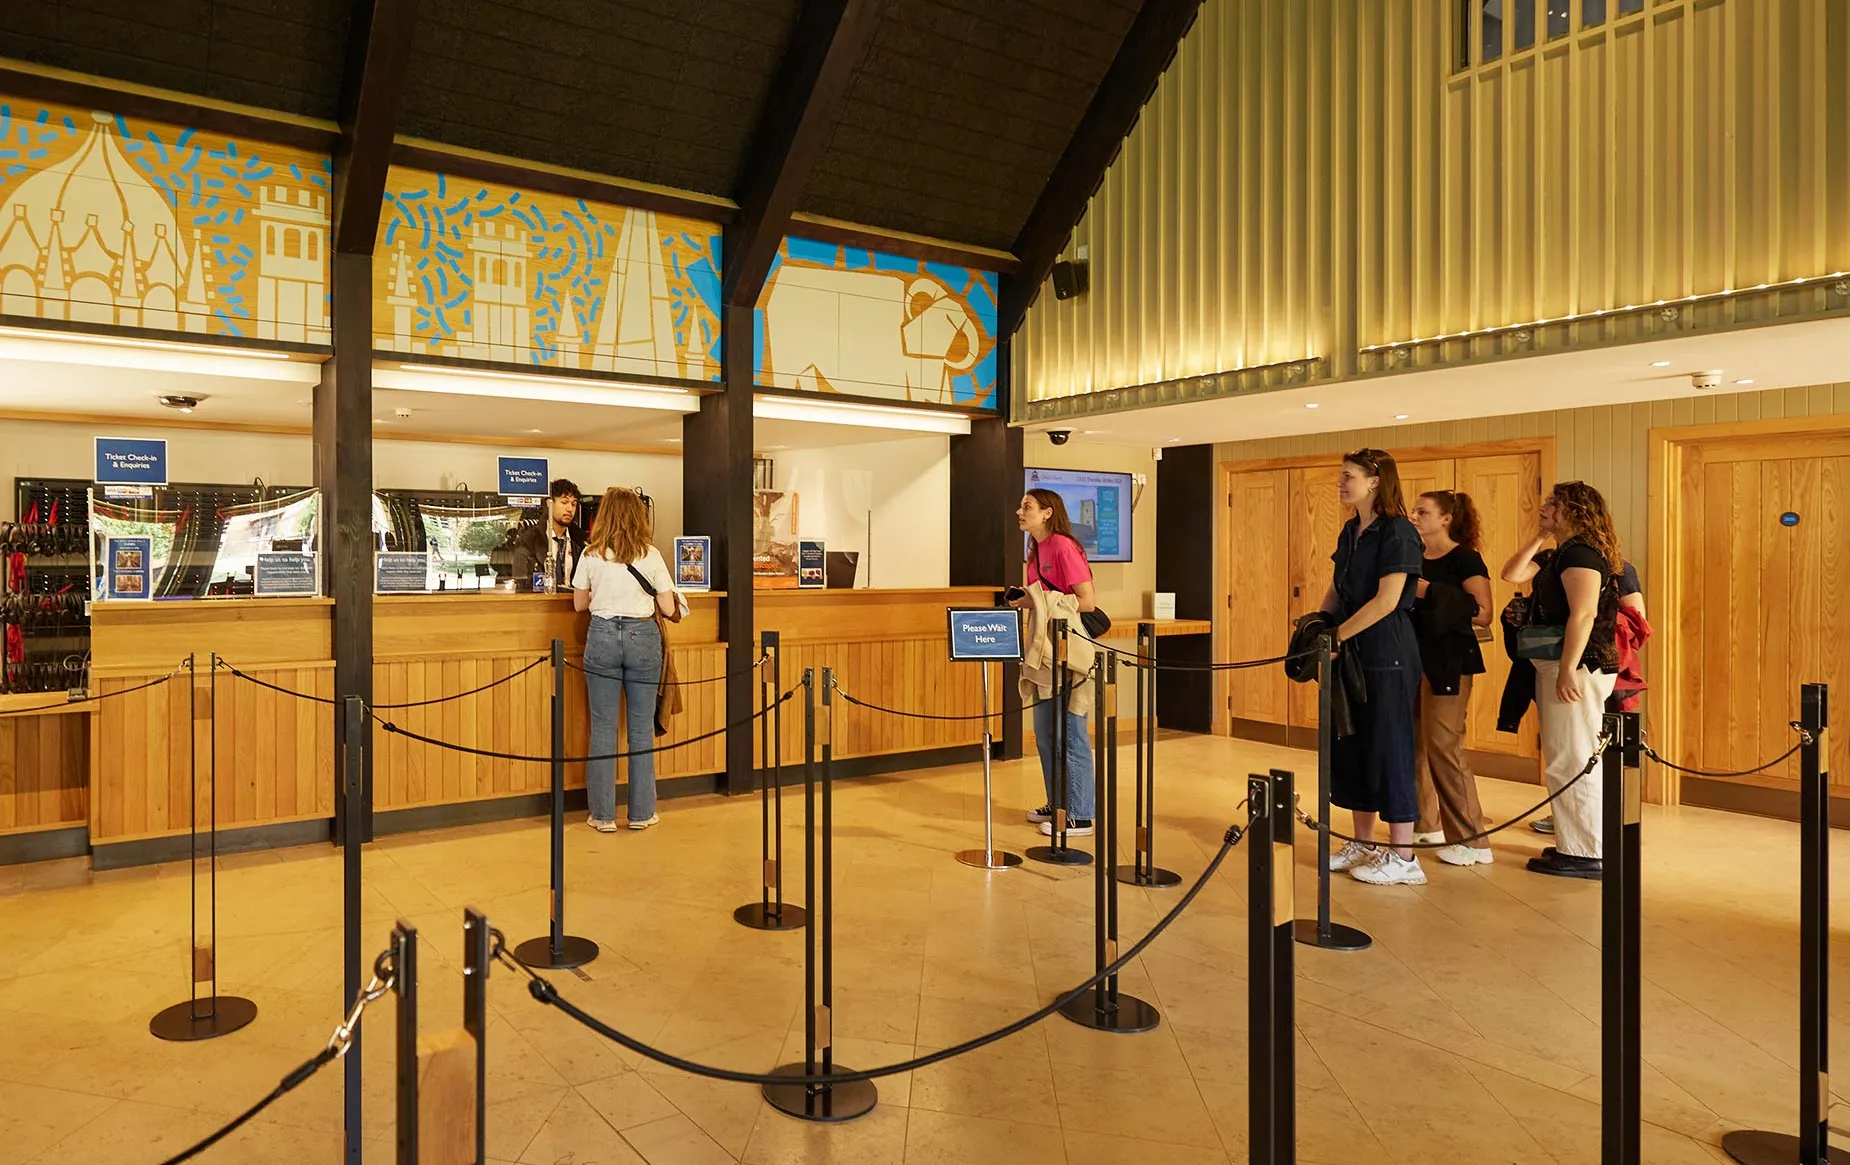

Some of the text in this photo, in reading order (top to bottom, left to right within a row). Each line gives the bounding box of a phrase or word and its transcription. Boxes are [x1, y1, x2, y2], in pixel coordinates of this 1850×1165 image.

[128, 453, 157, 461] Check-in
[120, 461, 150, 469] Enquiries
[963, 624, 1006, 632] Please Wait
[975, 635, 996, 643] Here
